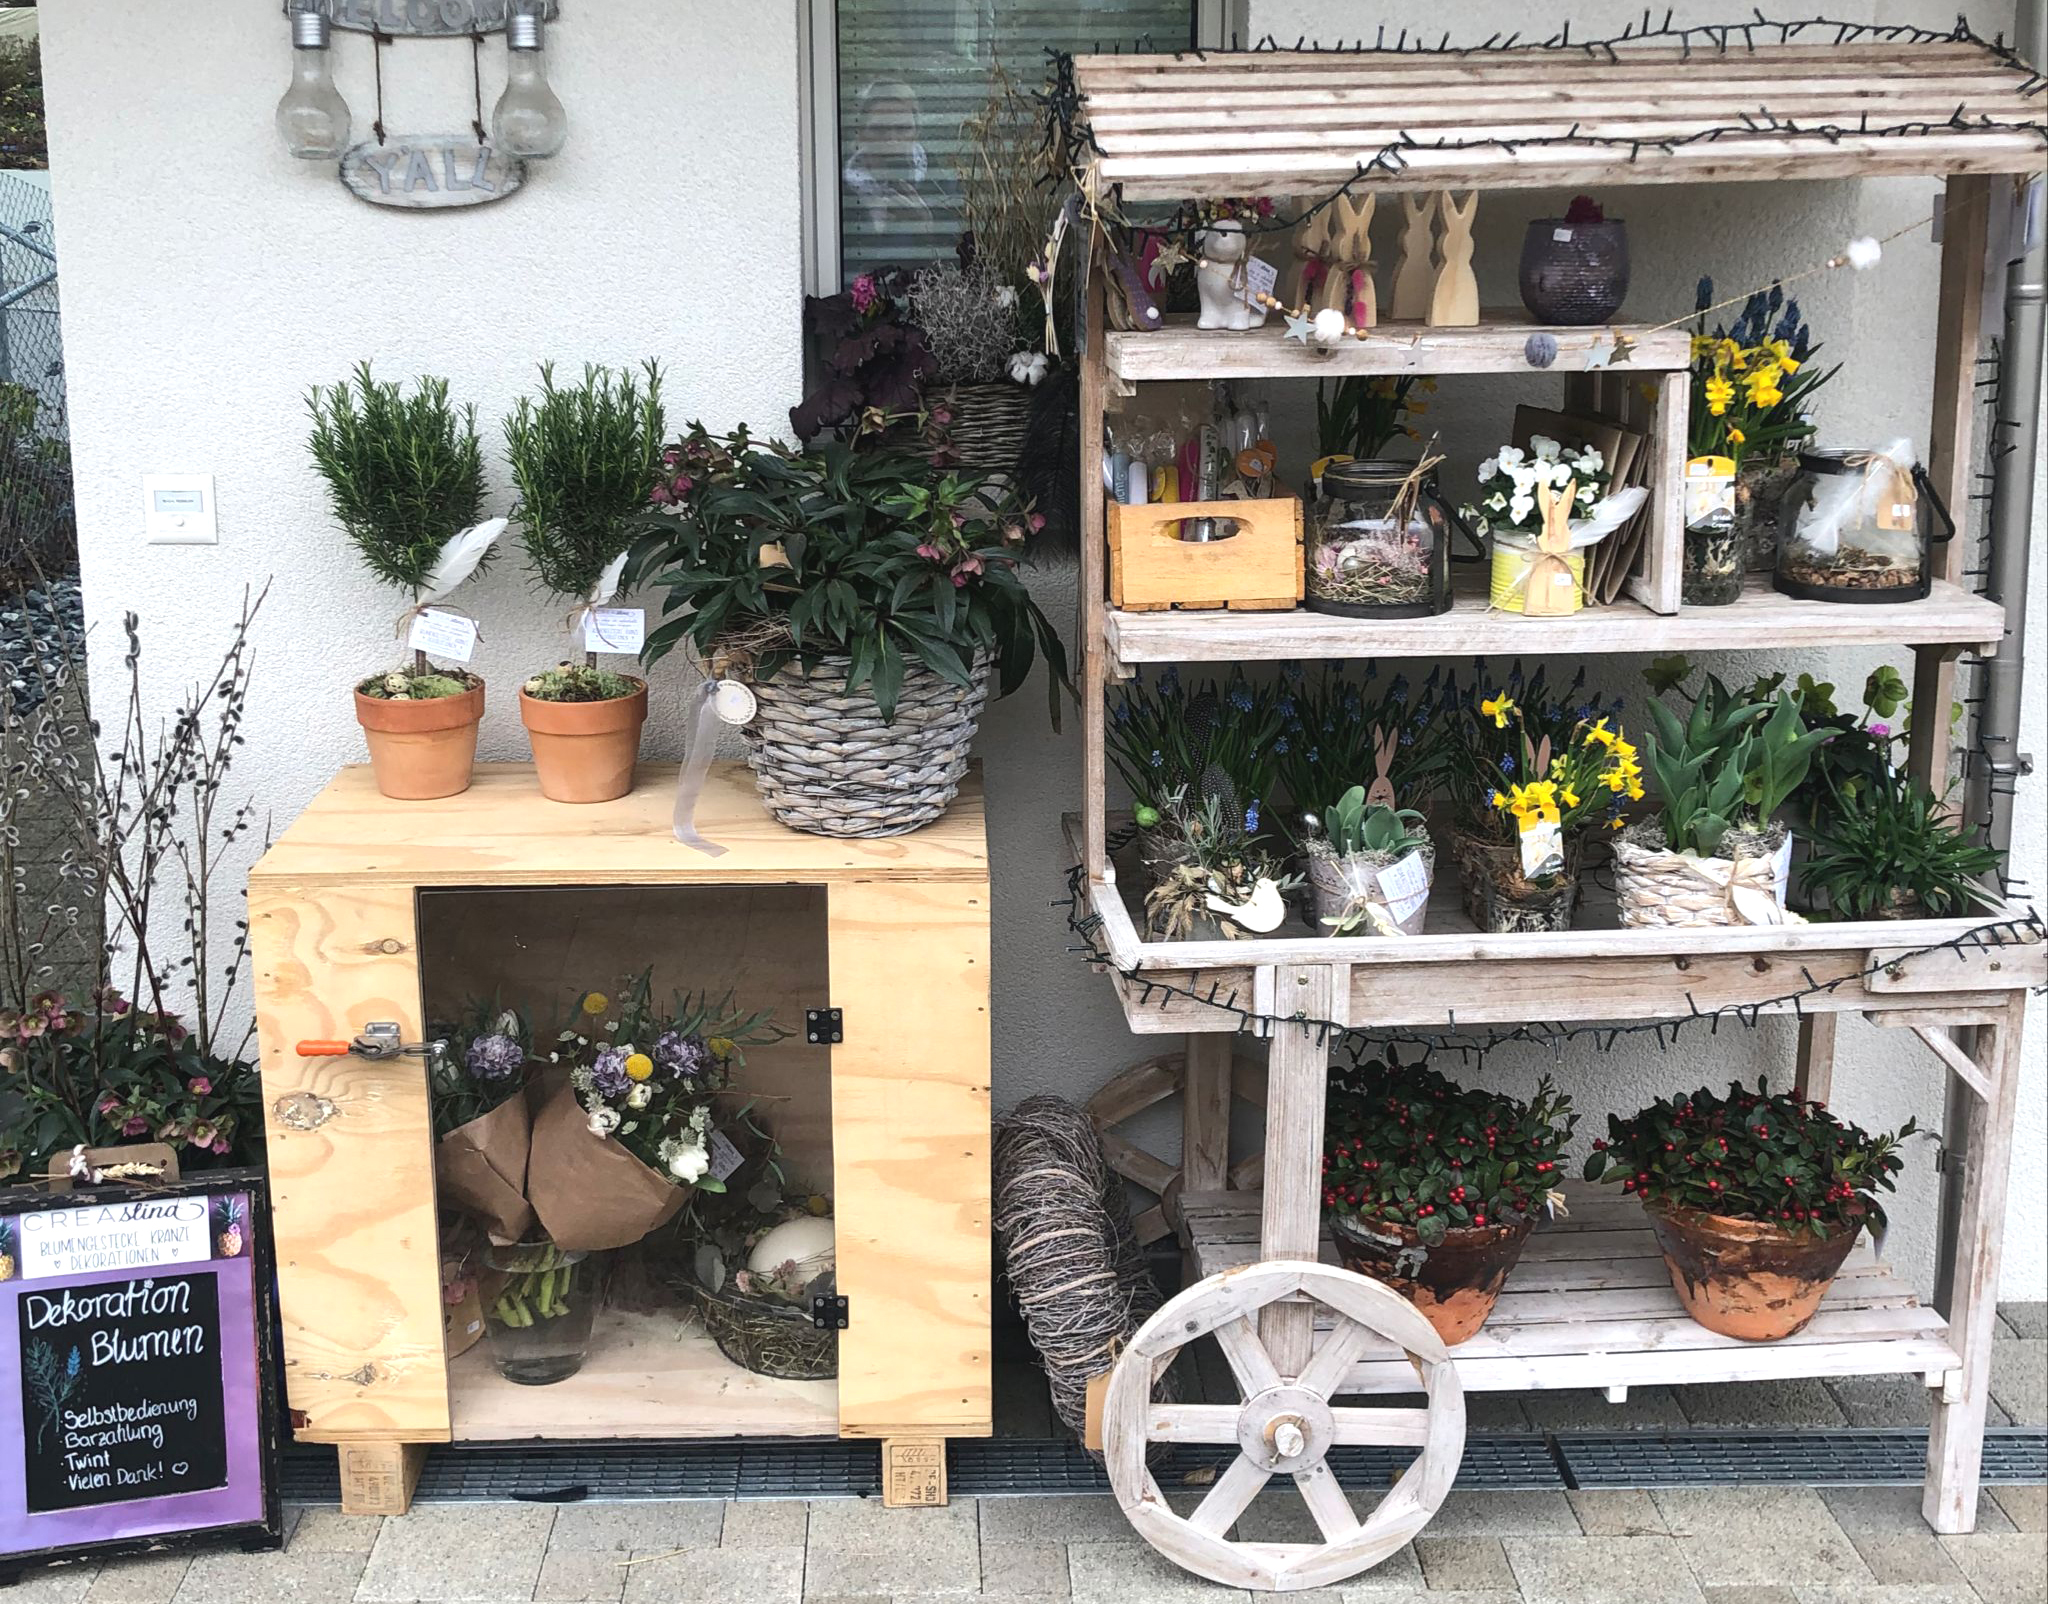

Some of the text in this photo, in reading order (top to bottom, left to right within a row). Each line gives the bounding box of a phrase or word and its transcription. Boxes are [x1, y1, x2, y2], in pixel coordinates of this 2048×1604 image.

[40, 1231, 140, 1257] BLUMENGESTECKE
[70, 1248, 160, 1271] DEKORATIONEN
[26, 1279, 191, 1330] Dekoration
[91, 1325, 204, 1366] Blumen
[64, 1398, 197, 1430] Selbstbedienung
[64, 1423, 164, 1449] Barzahlung
[64, 1450, 110, 1471] Twint
[69, 1461, 164, 1491] Vielen Dank!
